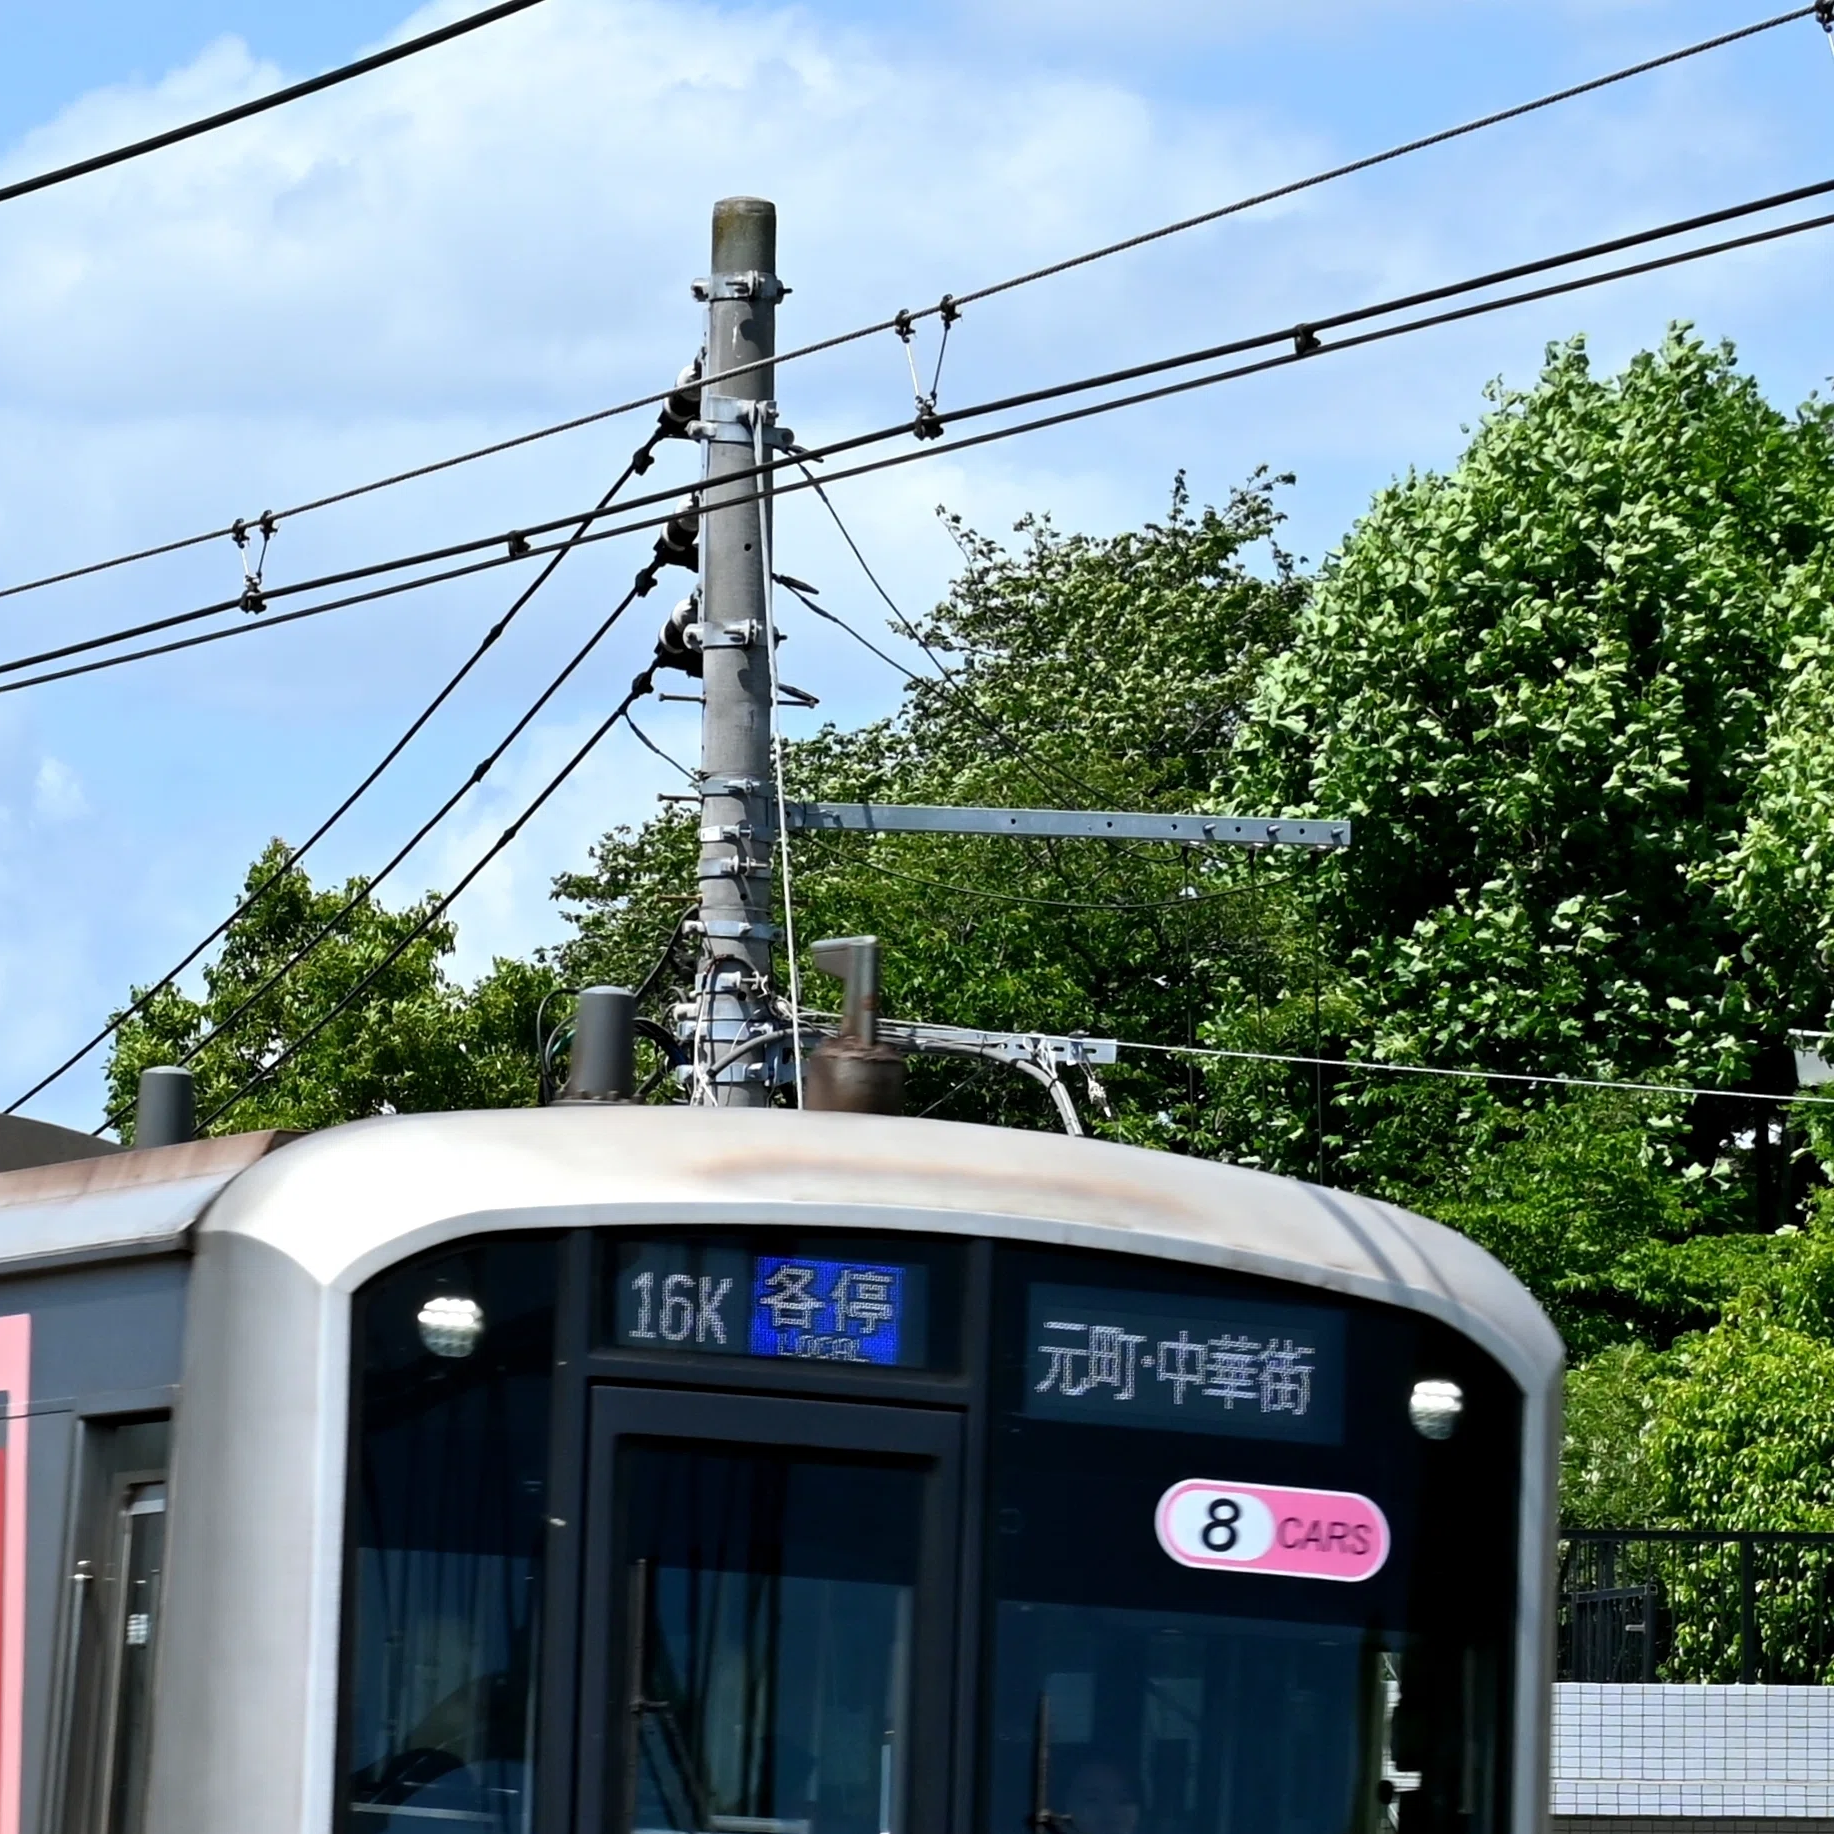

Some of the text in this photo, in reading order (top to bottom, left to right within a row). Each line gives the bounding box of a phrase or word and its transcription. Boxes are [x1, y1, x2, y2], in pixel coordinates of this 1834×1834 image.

[628, 1271, 733, 1345] 16K
[759, 1264, 894, 1334] 各停
[1201, 1497, 1373, 1556] 8 CARS
